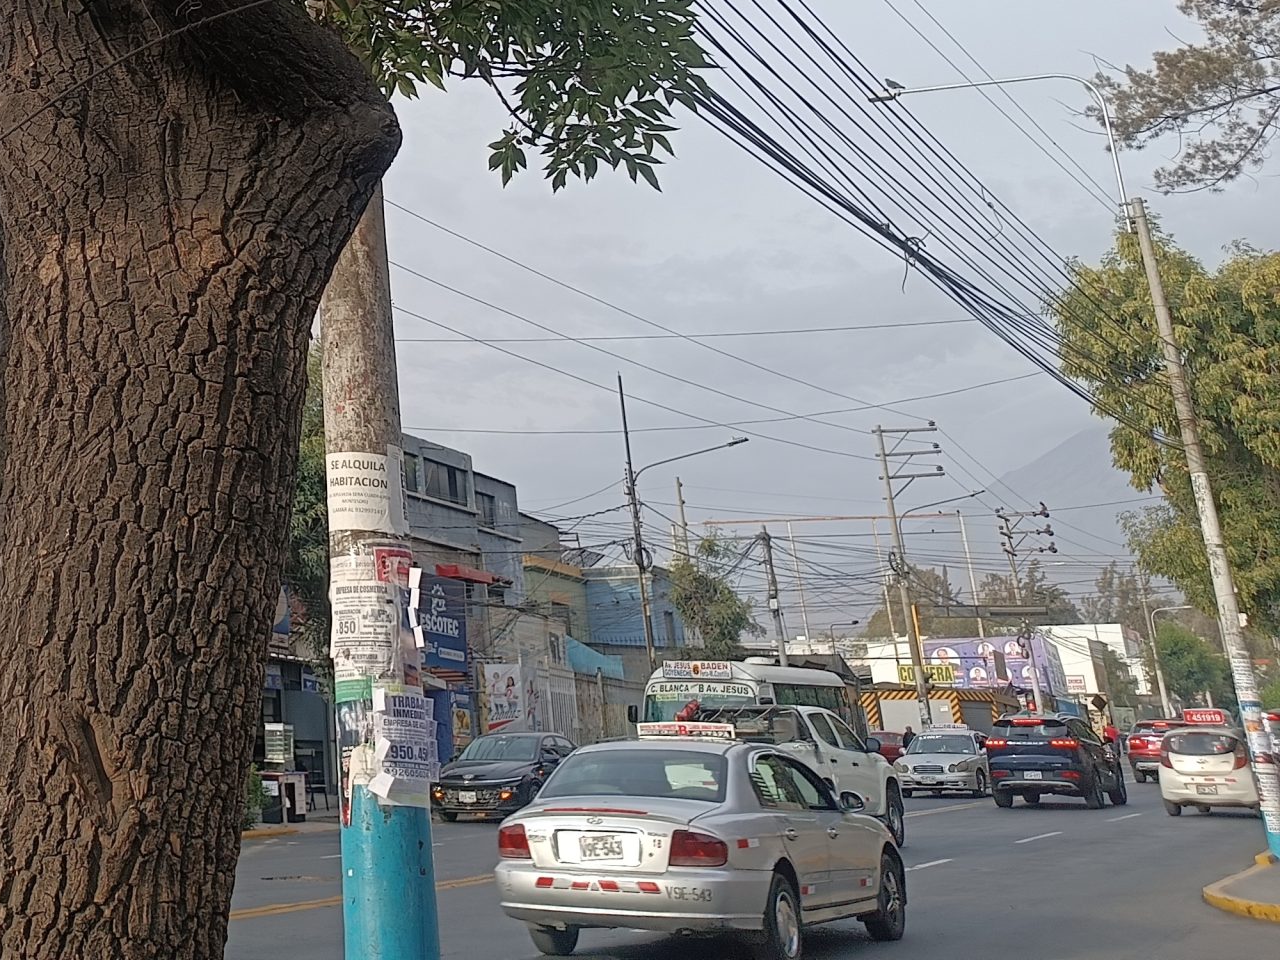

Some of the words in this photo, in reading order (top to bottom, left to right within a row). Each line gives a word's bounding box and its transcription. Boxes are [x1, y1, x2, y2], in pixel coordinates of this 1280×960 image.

[331, 460, 340, 470] SE
[341, 459, 386, 472] ALQUILA
[329, 476, 388, 489] HABITACION
[339, 621, 356, 635] 850
[673, 661, 691, 670] JESUS
[700, 662, 728, 670] BADEN
[900, 666, 953, 683] COERA
[659, 683, 690, 693] BLANCA
[706, 684, 719, 693] Av.
[720, 685, 750, 695] JESUS
[677, 724, 689, 736] B
[391, 744, 413, 760] 950
